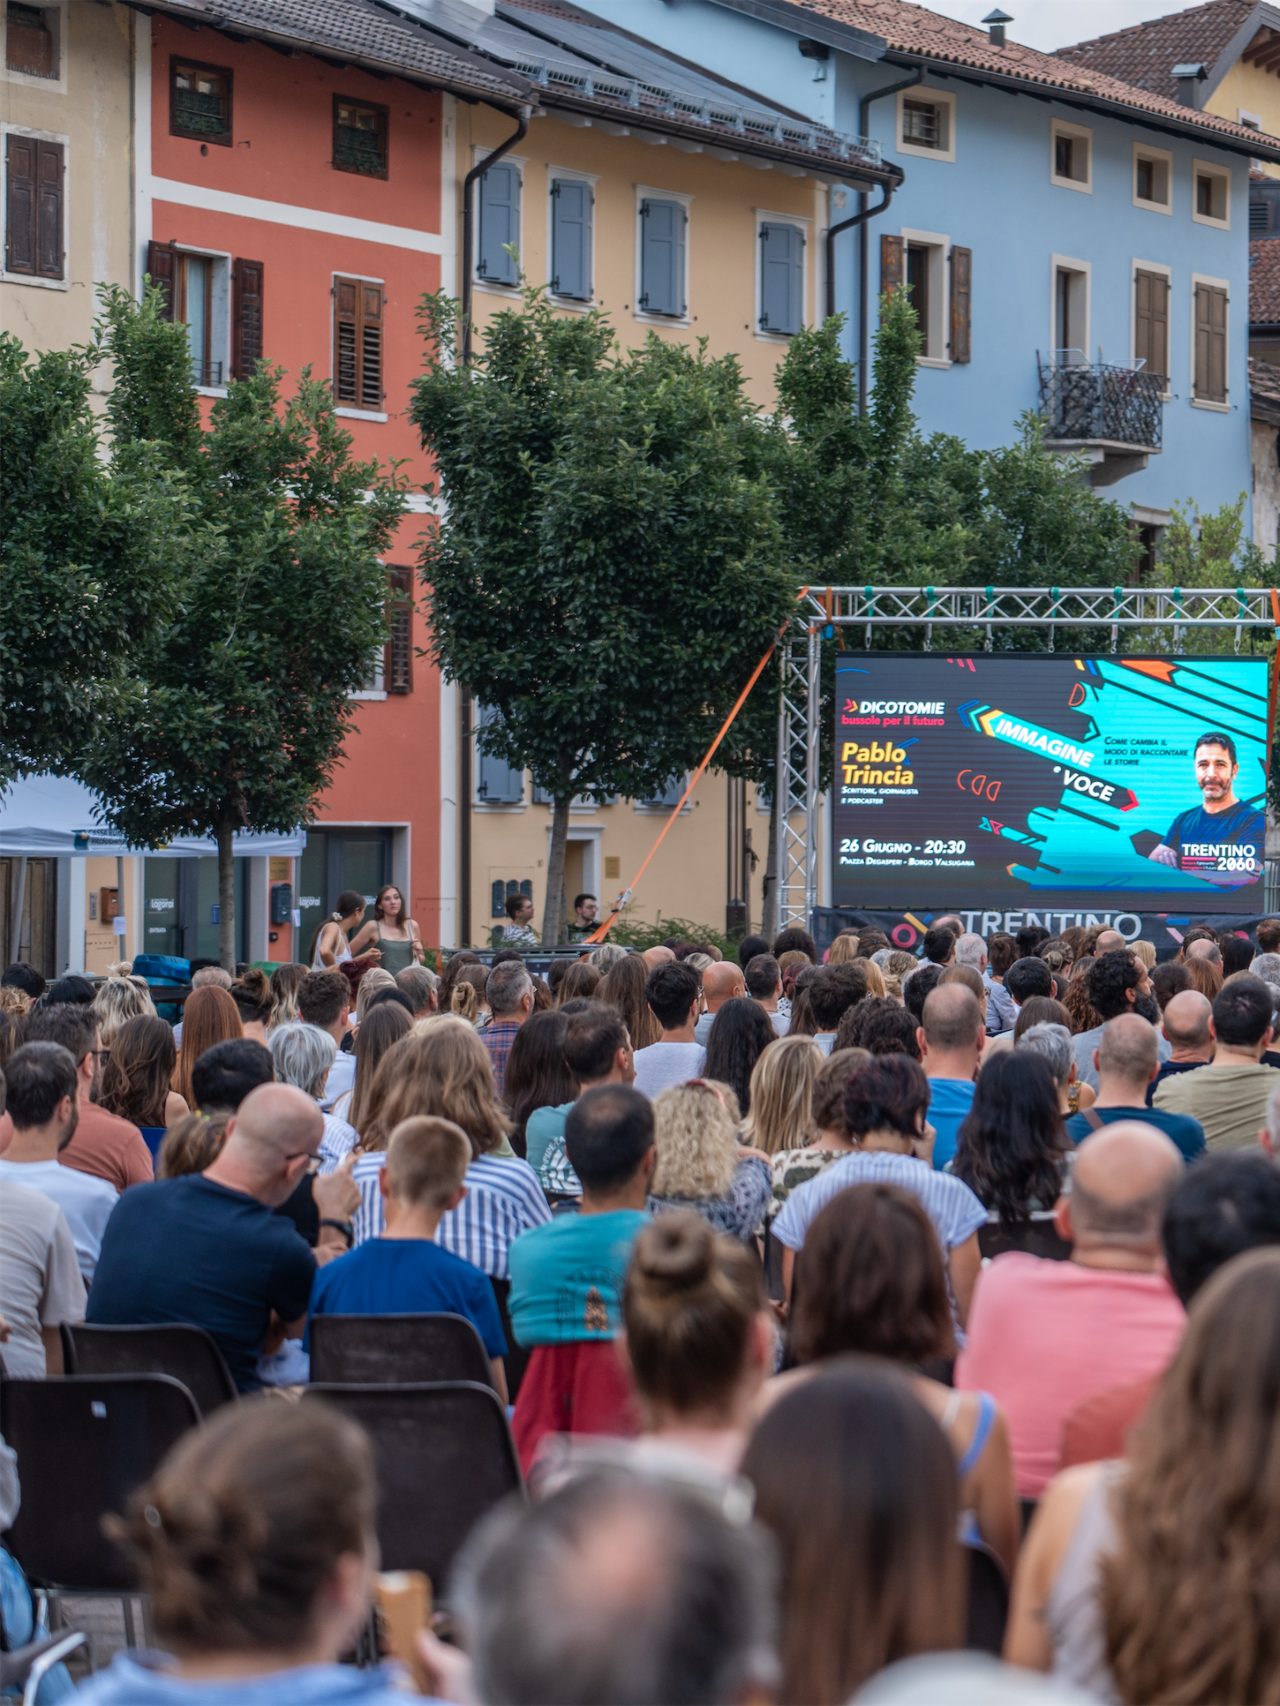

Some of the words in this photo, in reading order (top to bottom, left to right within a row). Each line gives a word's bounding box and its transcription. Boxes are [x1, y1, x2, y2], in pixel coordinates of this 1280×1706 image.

[859, 700, 945, 715] DICOTOMIE
[841, 715, 881, 725] bussole
[882, 718, 902, 727] per
[904, 716, 910, 725] il
[912, 716, 945, 726] futuro
[841, 741, 907, 763] Pablo
[996, 719, 1096, 768] IMMAGINE
[842, 764, 914, 785] Trincia
[1063, 768, 1117, 802] VOCE
[839, 838, 860, 853] 26
[923, 840, 967, 854] 20:30
[1181, 843, 1256, 858] TRENTINO
[1217, 857, 1256, 872] 2060
[960, 911, 1142, 941] TRENTINO
